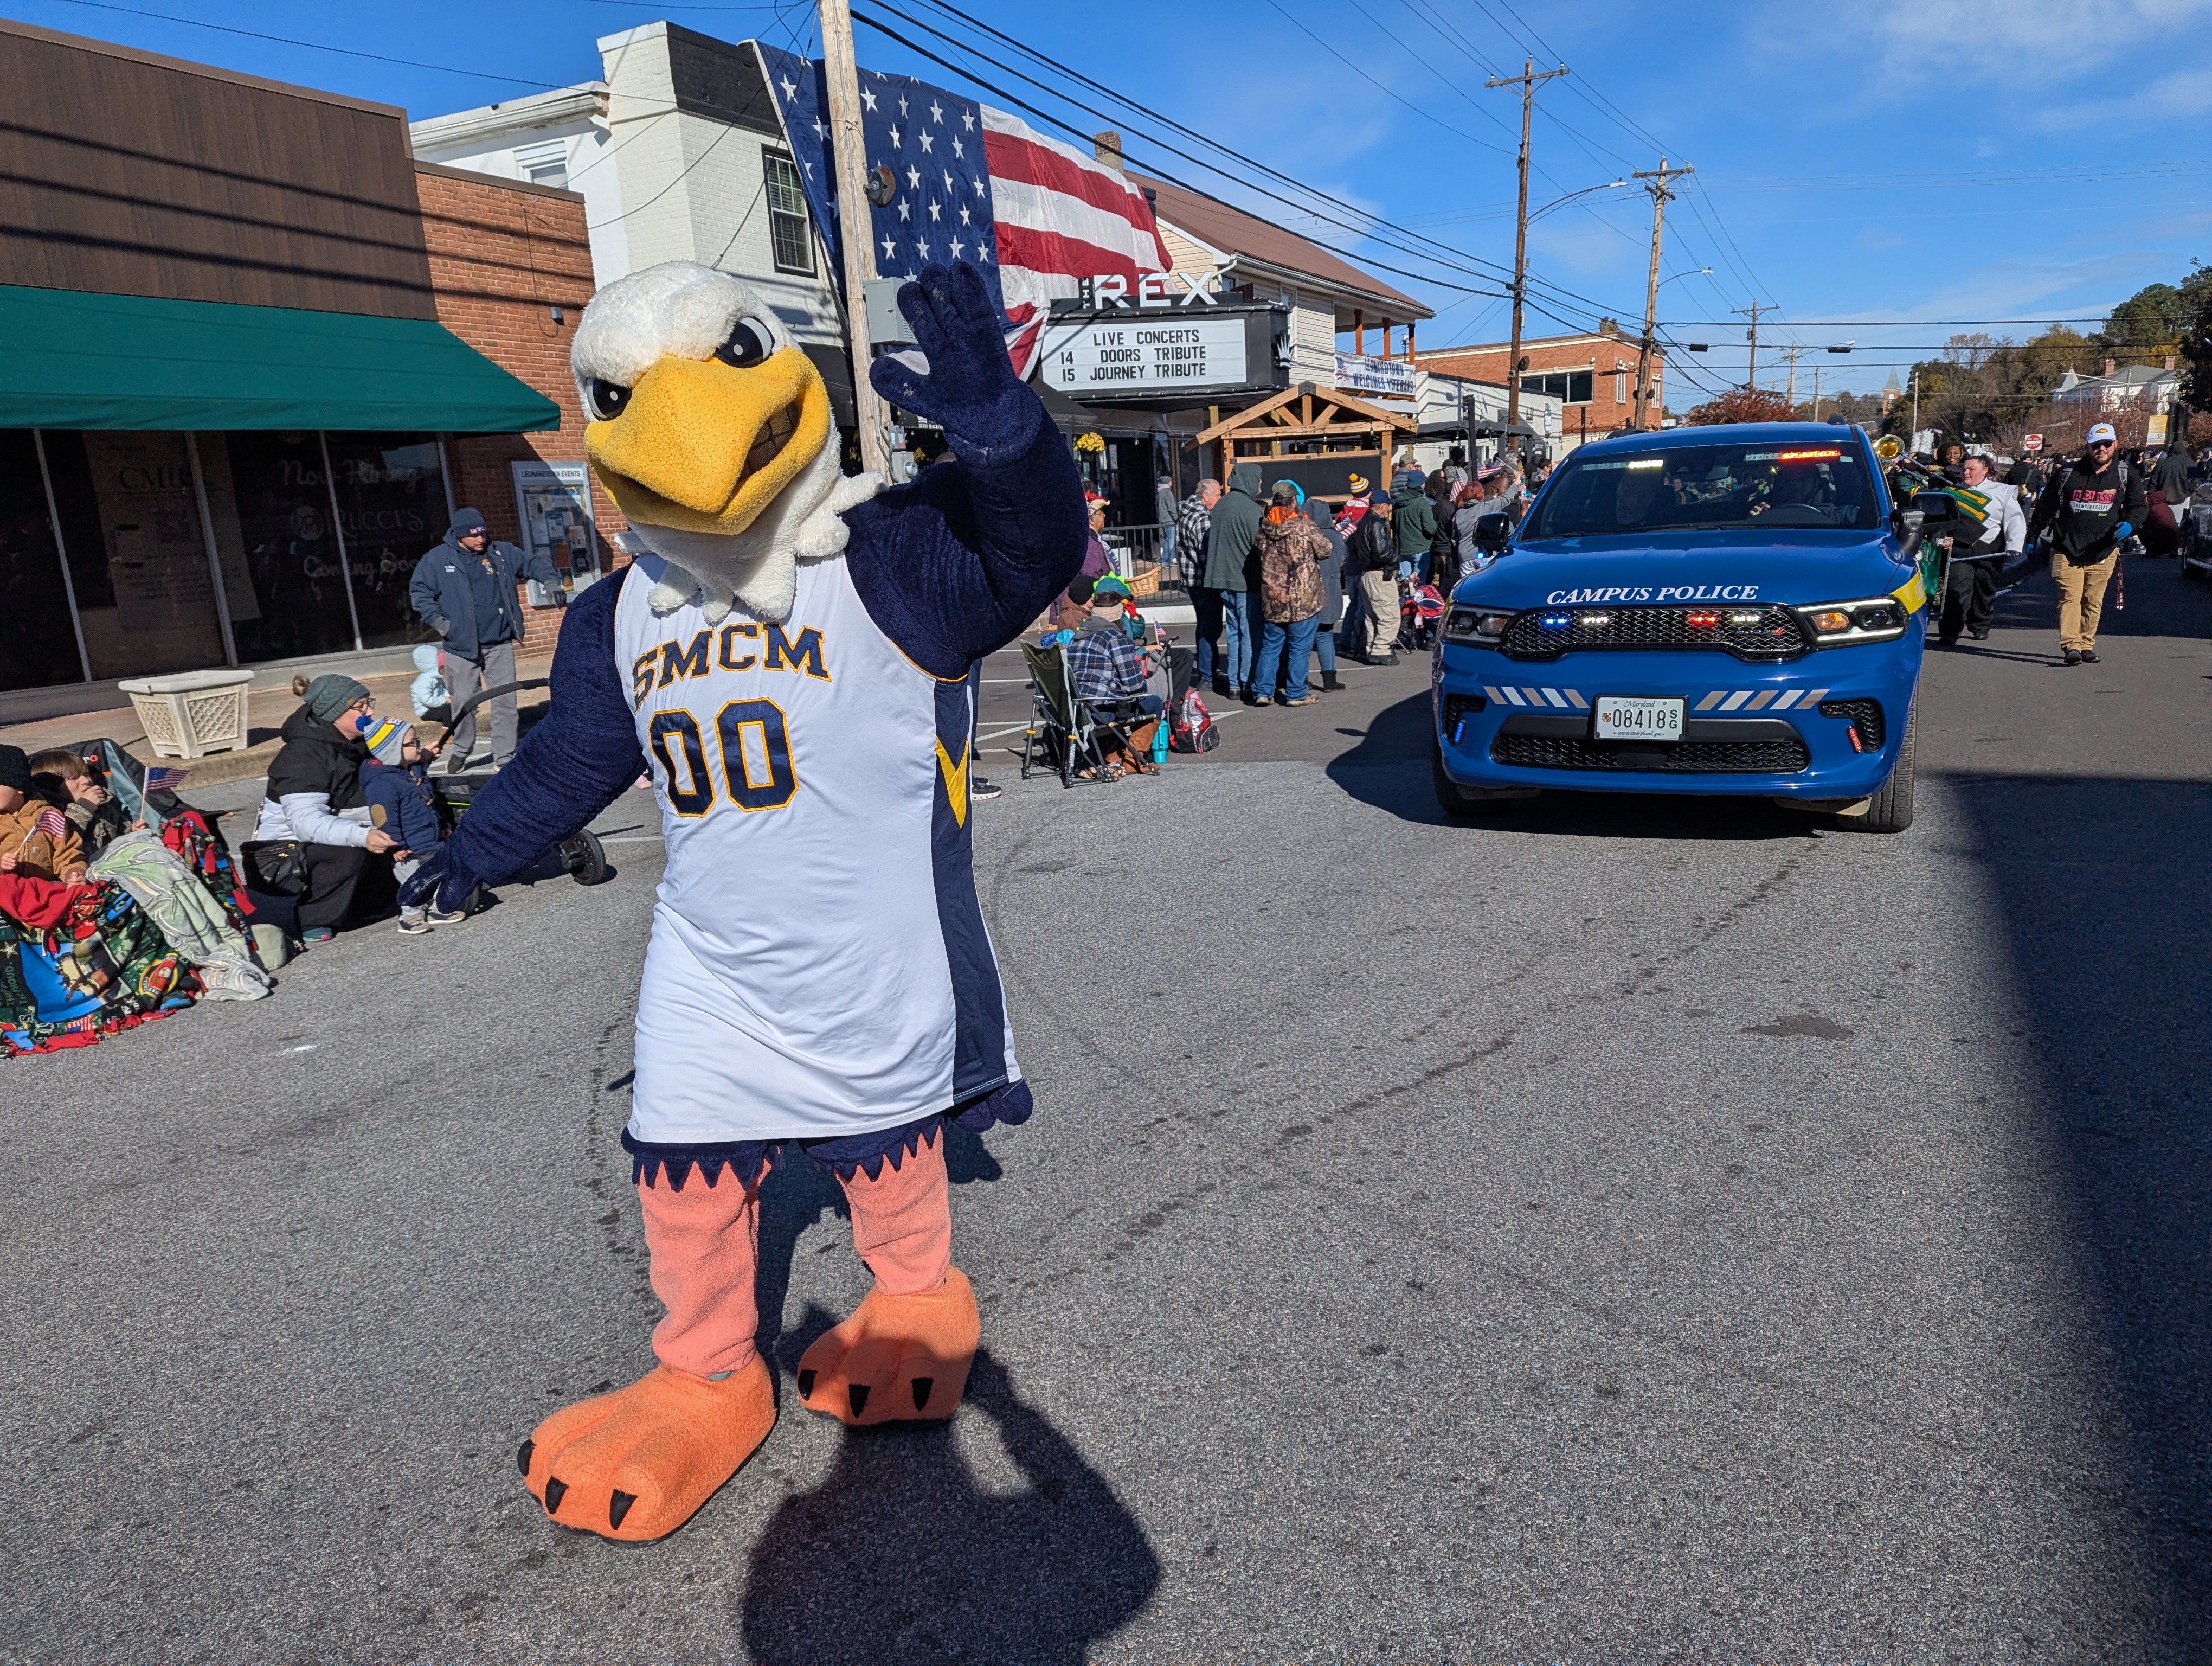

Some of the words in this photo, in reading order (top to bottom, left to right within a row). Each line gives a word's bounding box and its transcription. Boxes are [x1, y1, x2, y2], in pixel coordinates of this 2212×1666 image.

[1094, 271, 1218, 309] REX
[1094, 332, 1124, 346] LIVE
[1136, 329, 1199, 344] CONCERTS
[1061, 351, 1073, 364] 14
[1100, 348, 1141, 363] DOORS
[1154, 346, 1206, 360] TRIBUTE
[1063, 368, 1075, 381] 15
[1090, 365, 1145, 380] JOURNEY
[1154, 363, 1206, 377] TRIBUTE
[1365, 357, 1404, 376] LEONARDTOWN
[1353, 373, 1386, 390] WELCOMES
[1387, 377, 1413, 393] VETERANS
[2073, 502, 2108, 510] CHAMPIONSHIPS
[1547, 587, 1652, 605] CAMPUS
[1656, 586, 1759, 600] POLICE
[632, 622, 832, 715] SMCM
[1623, 700, 1656, 709] Maryland
[1613, 709, 1667, 729] 08418
[648, 697, 799, 817] 00
